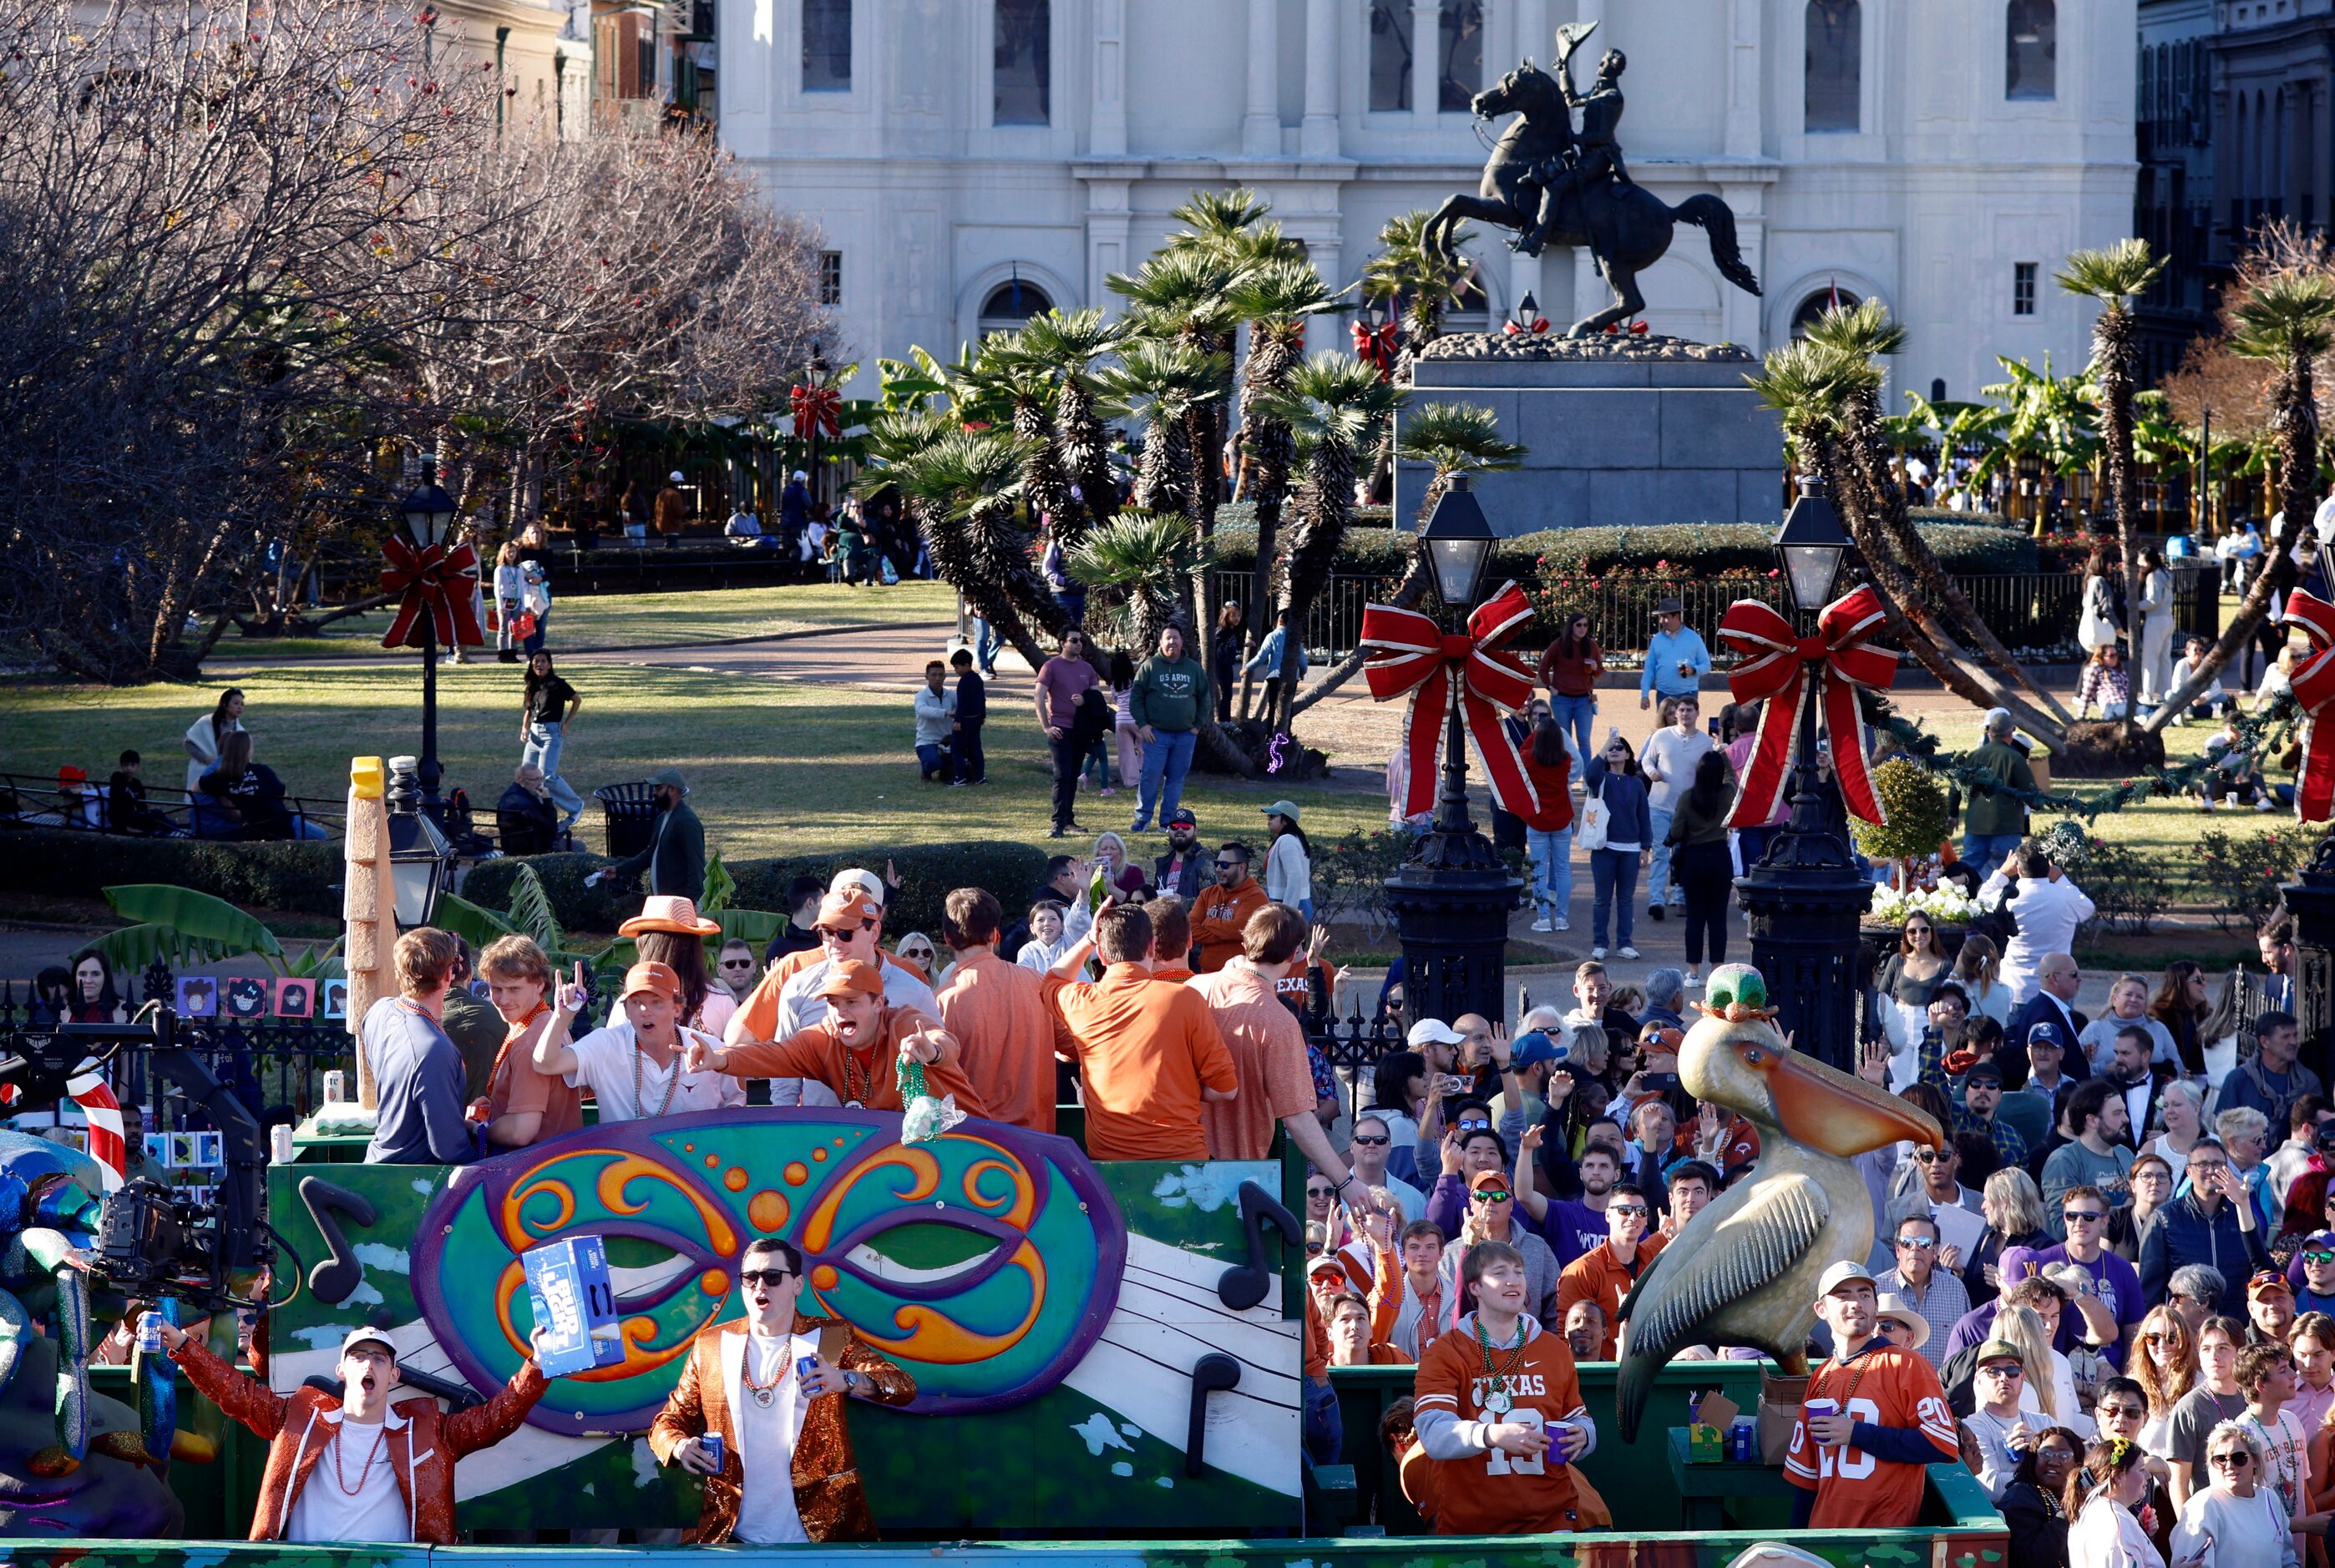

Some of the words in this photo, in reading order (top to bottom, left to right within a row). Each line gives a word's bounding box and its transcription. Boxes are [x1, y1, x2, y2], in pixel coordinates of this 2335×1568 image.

[1172, 673, 1191, 683] ARMY
[1276, 977, 1309, 993] EXA
[25, 1037, 52, 1050] TRIANGLE
[2023, 1261, 2038, 1277] W
[542, 1271, 569, 1347] LIGHT
[556, 1277, 579, 1334] BUD
[1917, 1396, 1952, 1428] 20
